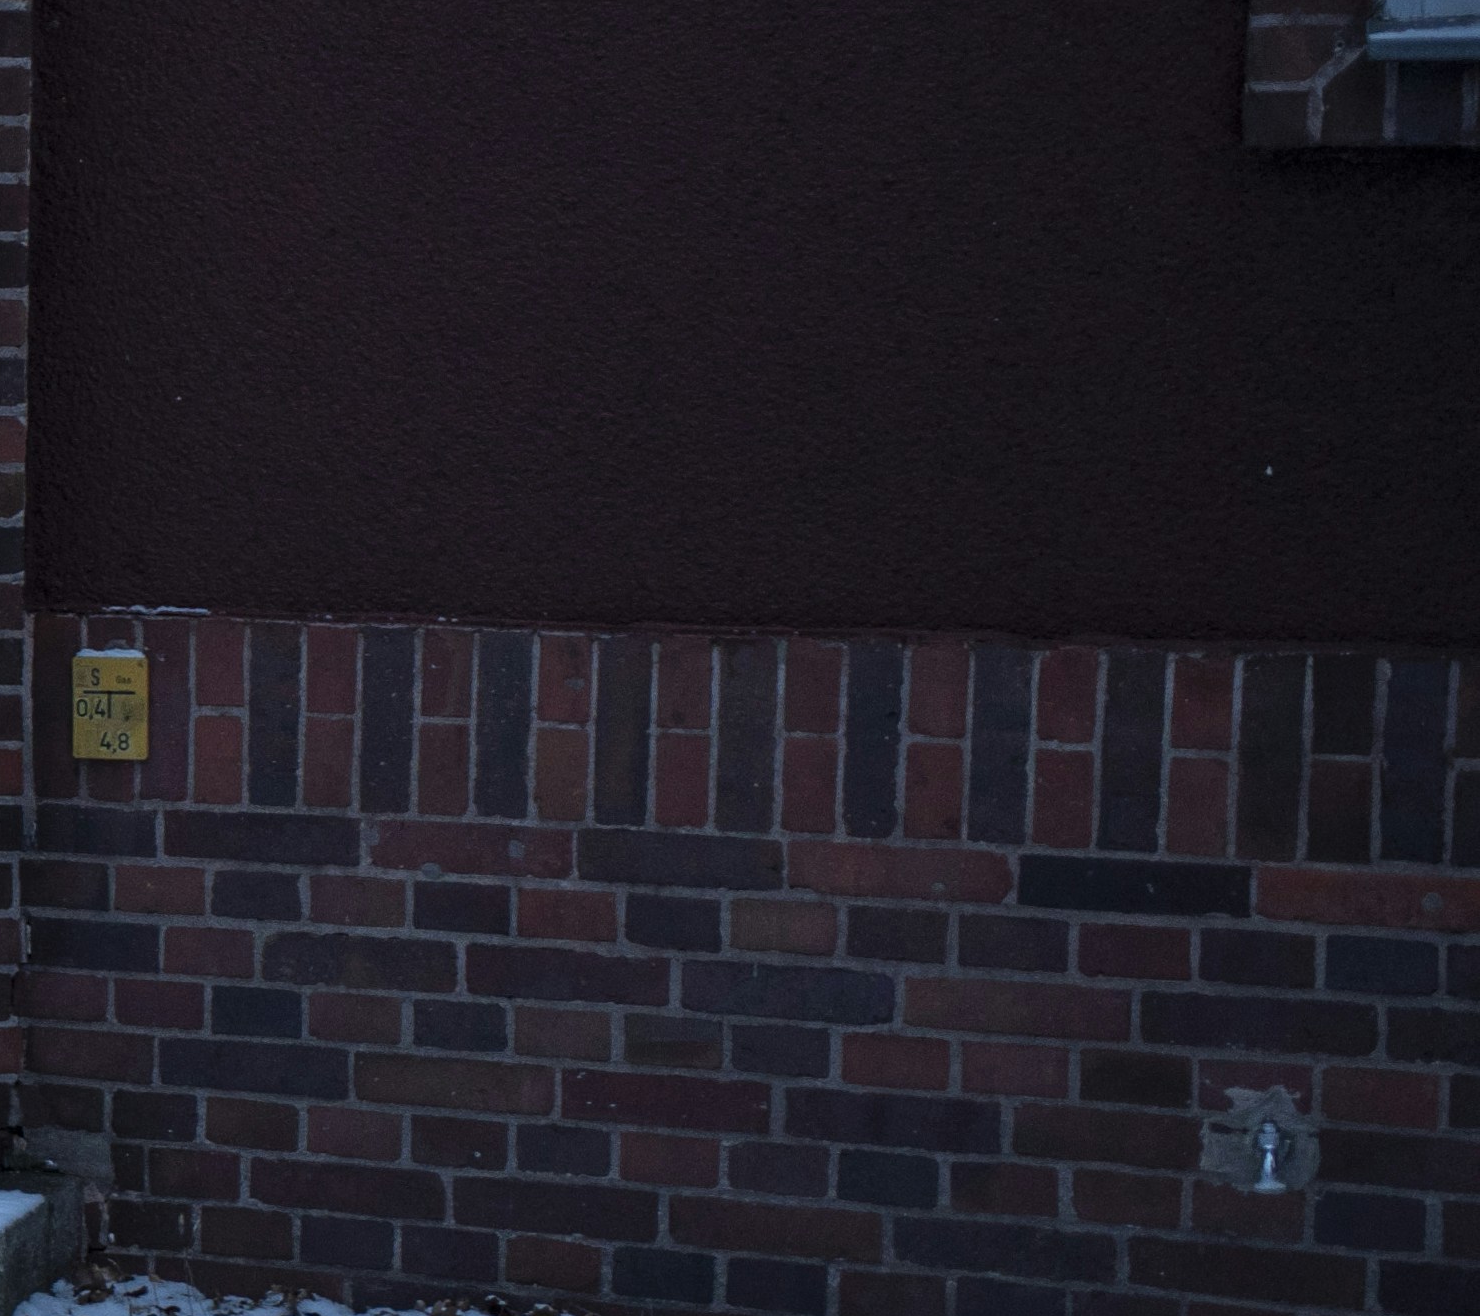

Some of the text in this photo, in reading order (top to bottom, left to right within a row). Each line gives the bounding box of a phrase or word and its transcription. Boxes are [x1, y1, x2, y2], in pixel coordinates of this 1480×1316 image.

[91, 667, 132, 686] S Gas
[76, 698, 106, 720] 0,4
[100, 732, 129, 754] 4,8
